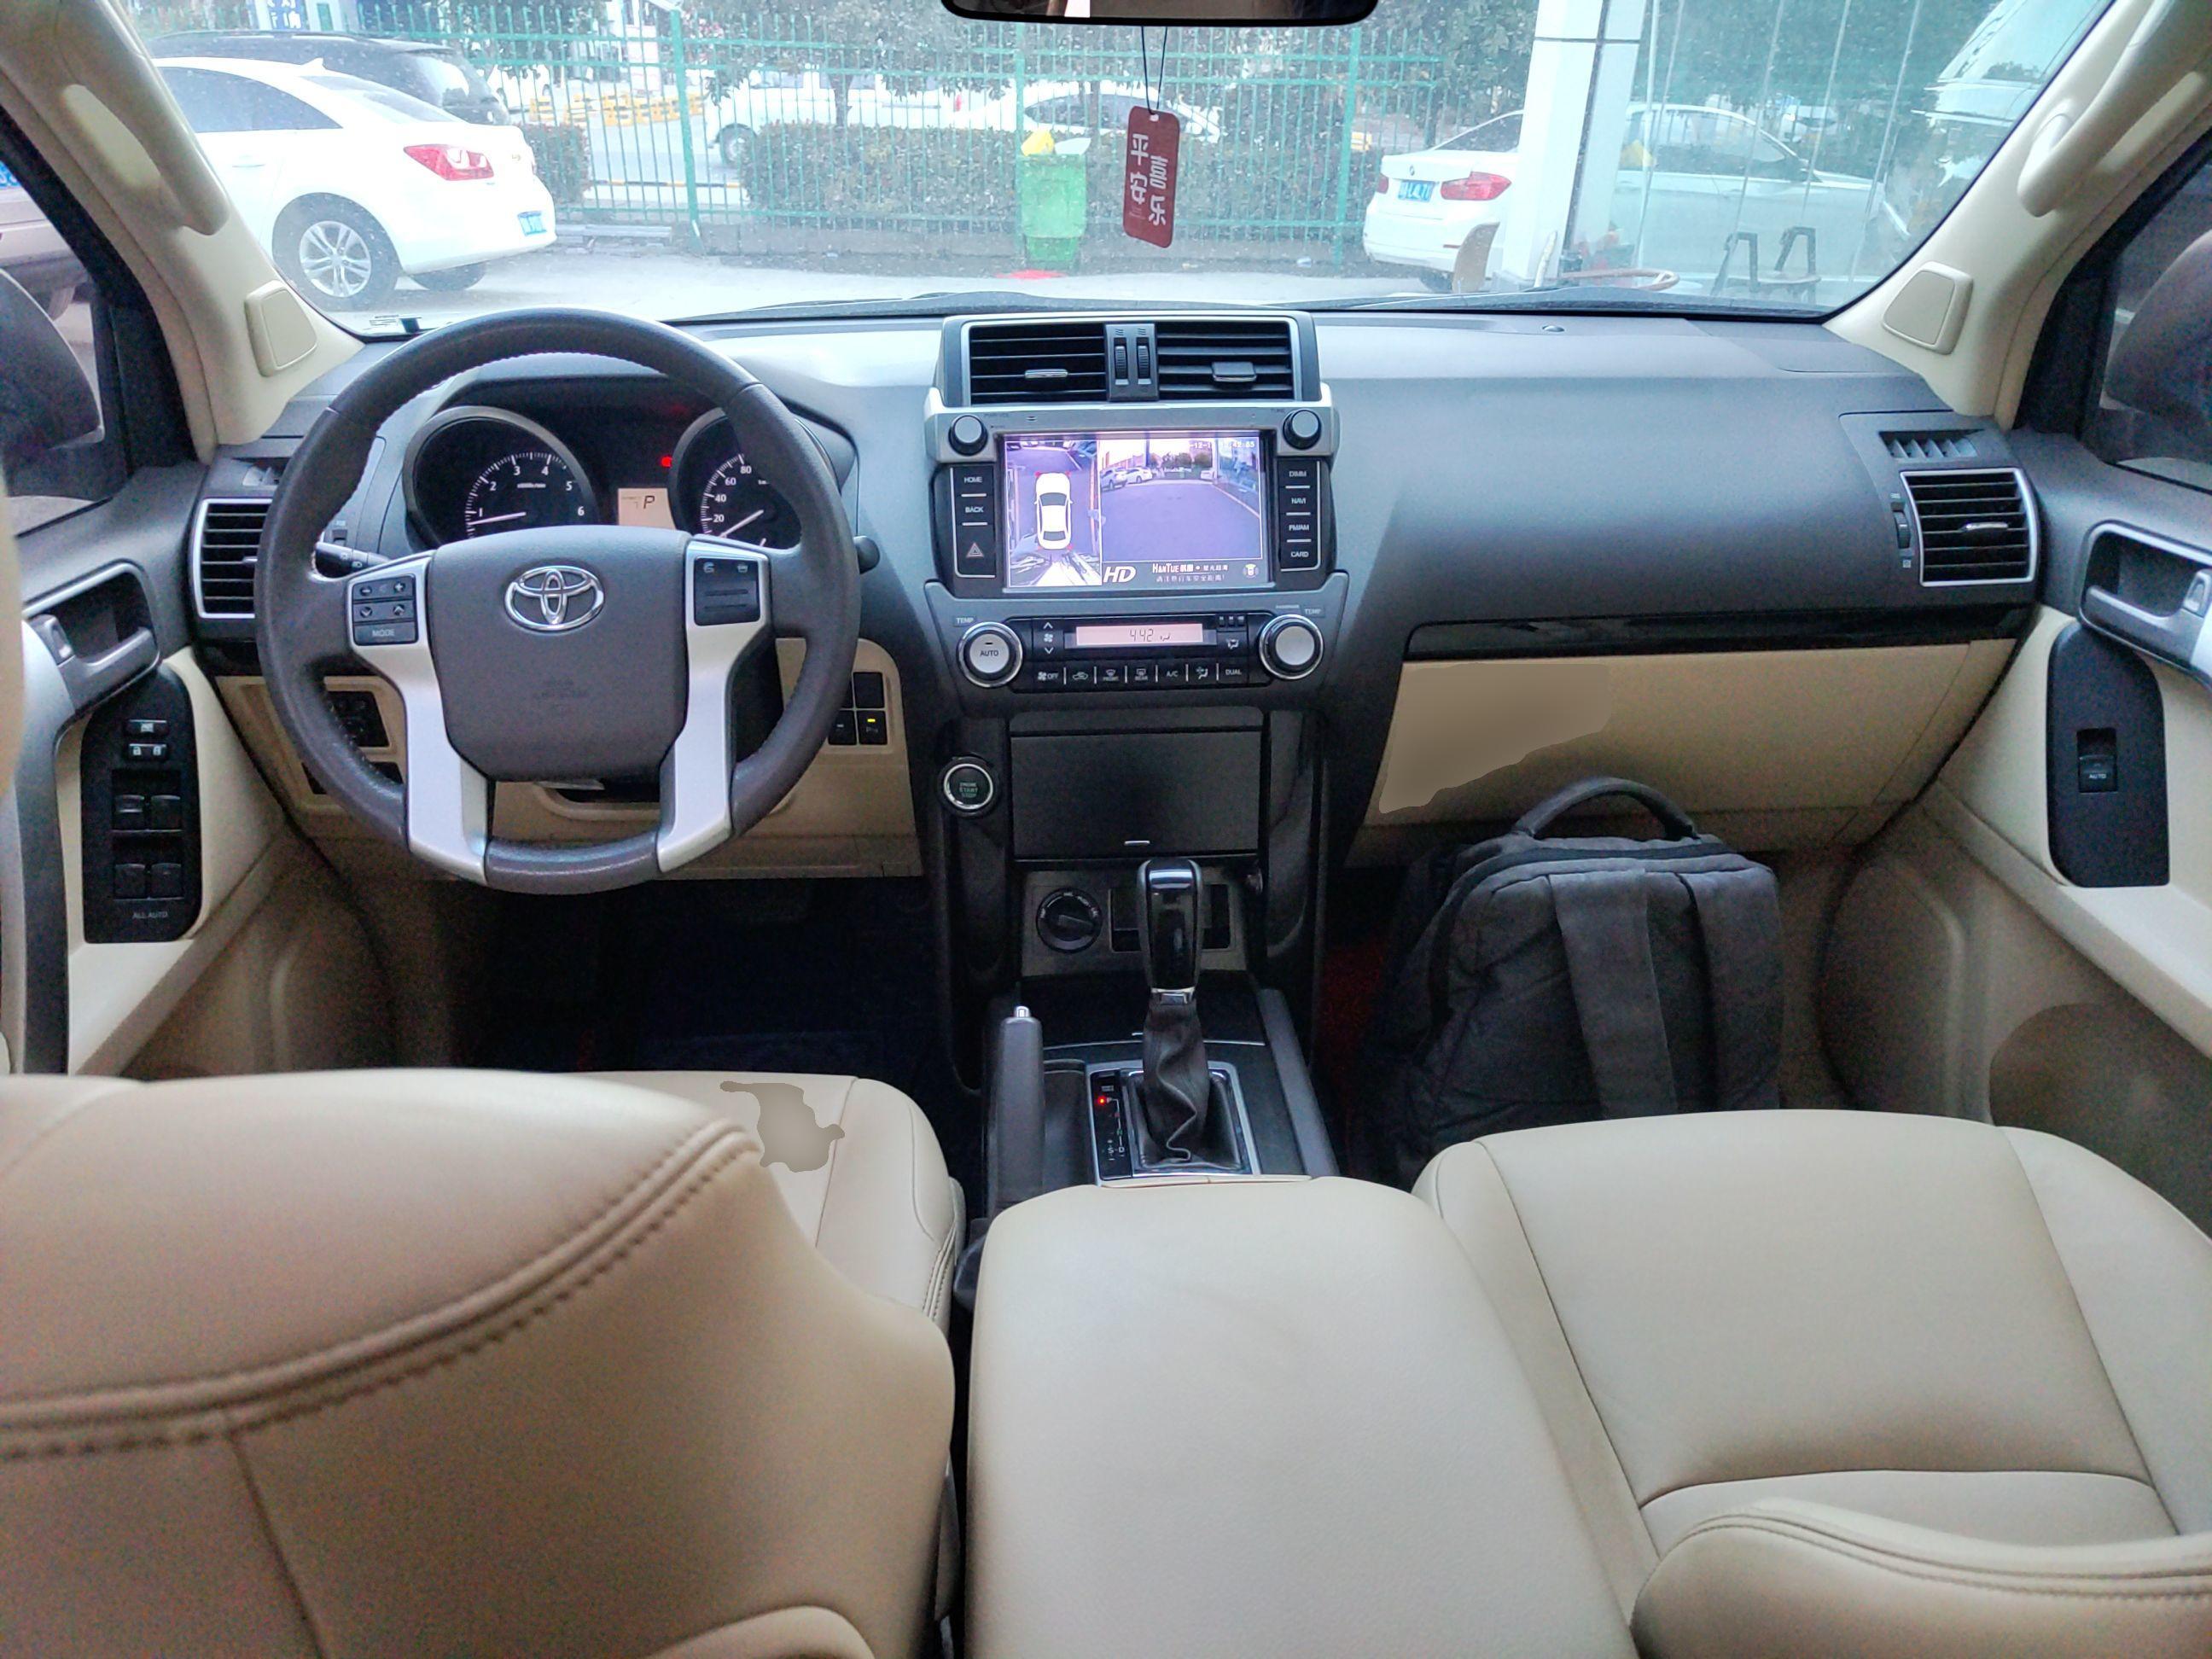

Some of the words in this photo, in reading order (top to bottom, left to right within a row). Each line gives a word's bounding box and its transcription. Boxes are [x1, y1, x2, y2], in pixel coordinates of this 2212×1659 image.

[1130, 133, 1149, 205] 平安
[1148, 155, 1168, 226] 喜乐
[514, 466, 521, 476] 3
[541, 466, 550, 476] 4
[740, 465, 752, 474] 80
[490, 481, 498, 492] 2
[566, 480, 573, 492] 5
[725, 477, 736, 486] 60
[643, 495, 655, 509] P
[715, 494, 726, 503] 40
[479, 508, 484, 517] 1
[578, 506, 585, 516] 6
[713, 515, 725, 523] 20
[1103, 566, 1137, 583] HD
